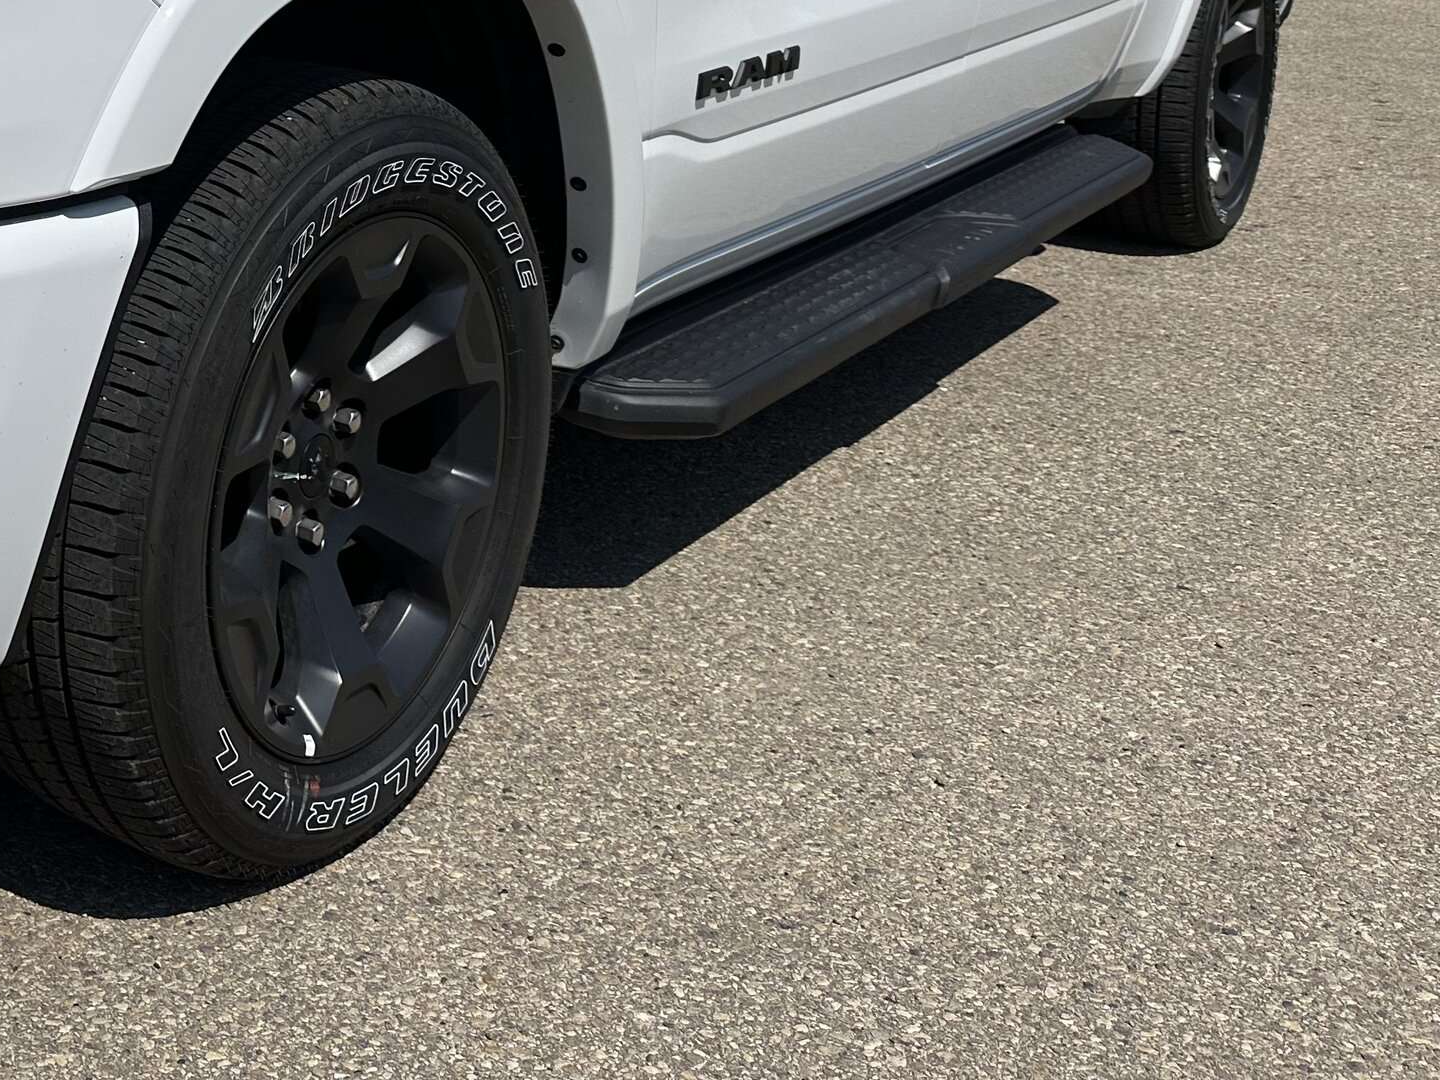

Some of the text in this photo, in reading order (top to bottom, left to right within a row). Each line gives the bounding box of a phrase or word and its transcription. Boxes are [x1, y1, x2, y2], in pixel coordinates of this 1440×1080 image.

[695, 44, 801, 102] RAM
[252, 156, 539, 344] BRIDGESTONE
[215, 619, 497, 832] DUELER H/L
